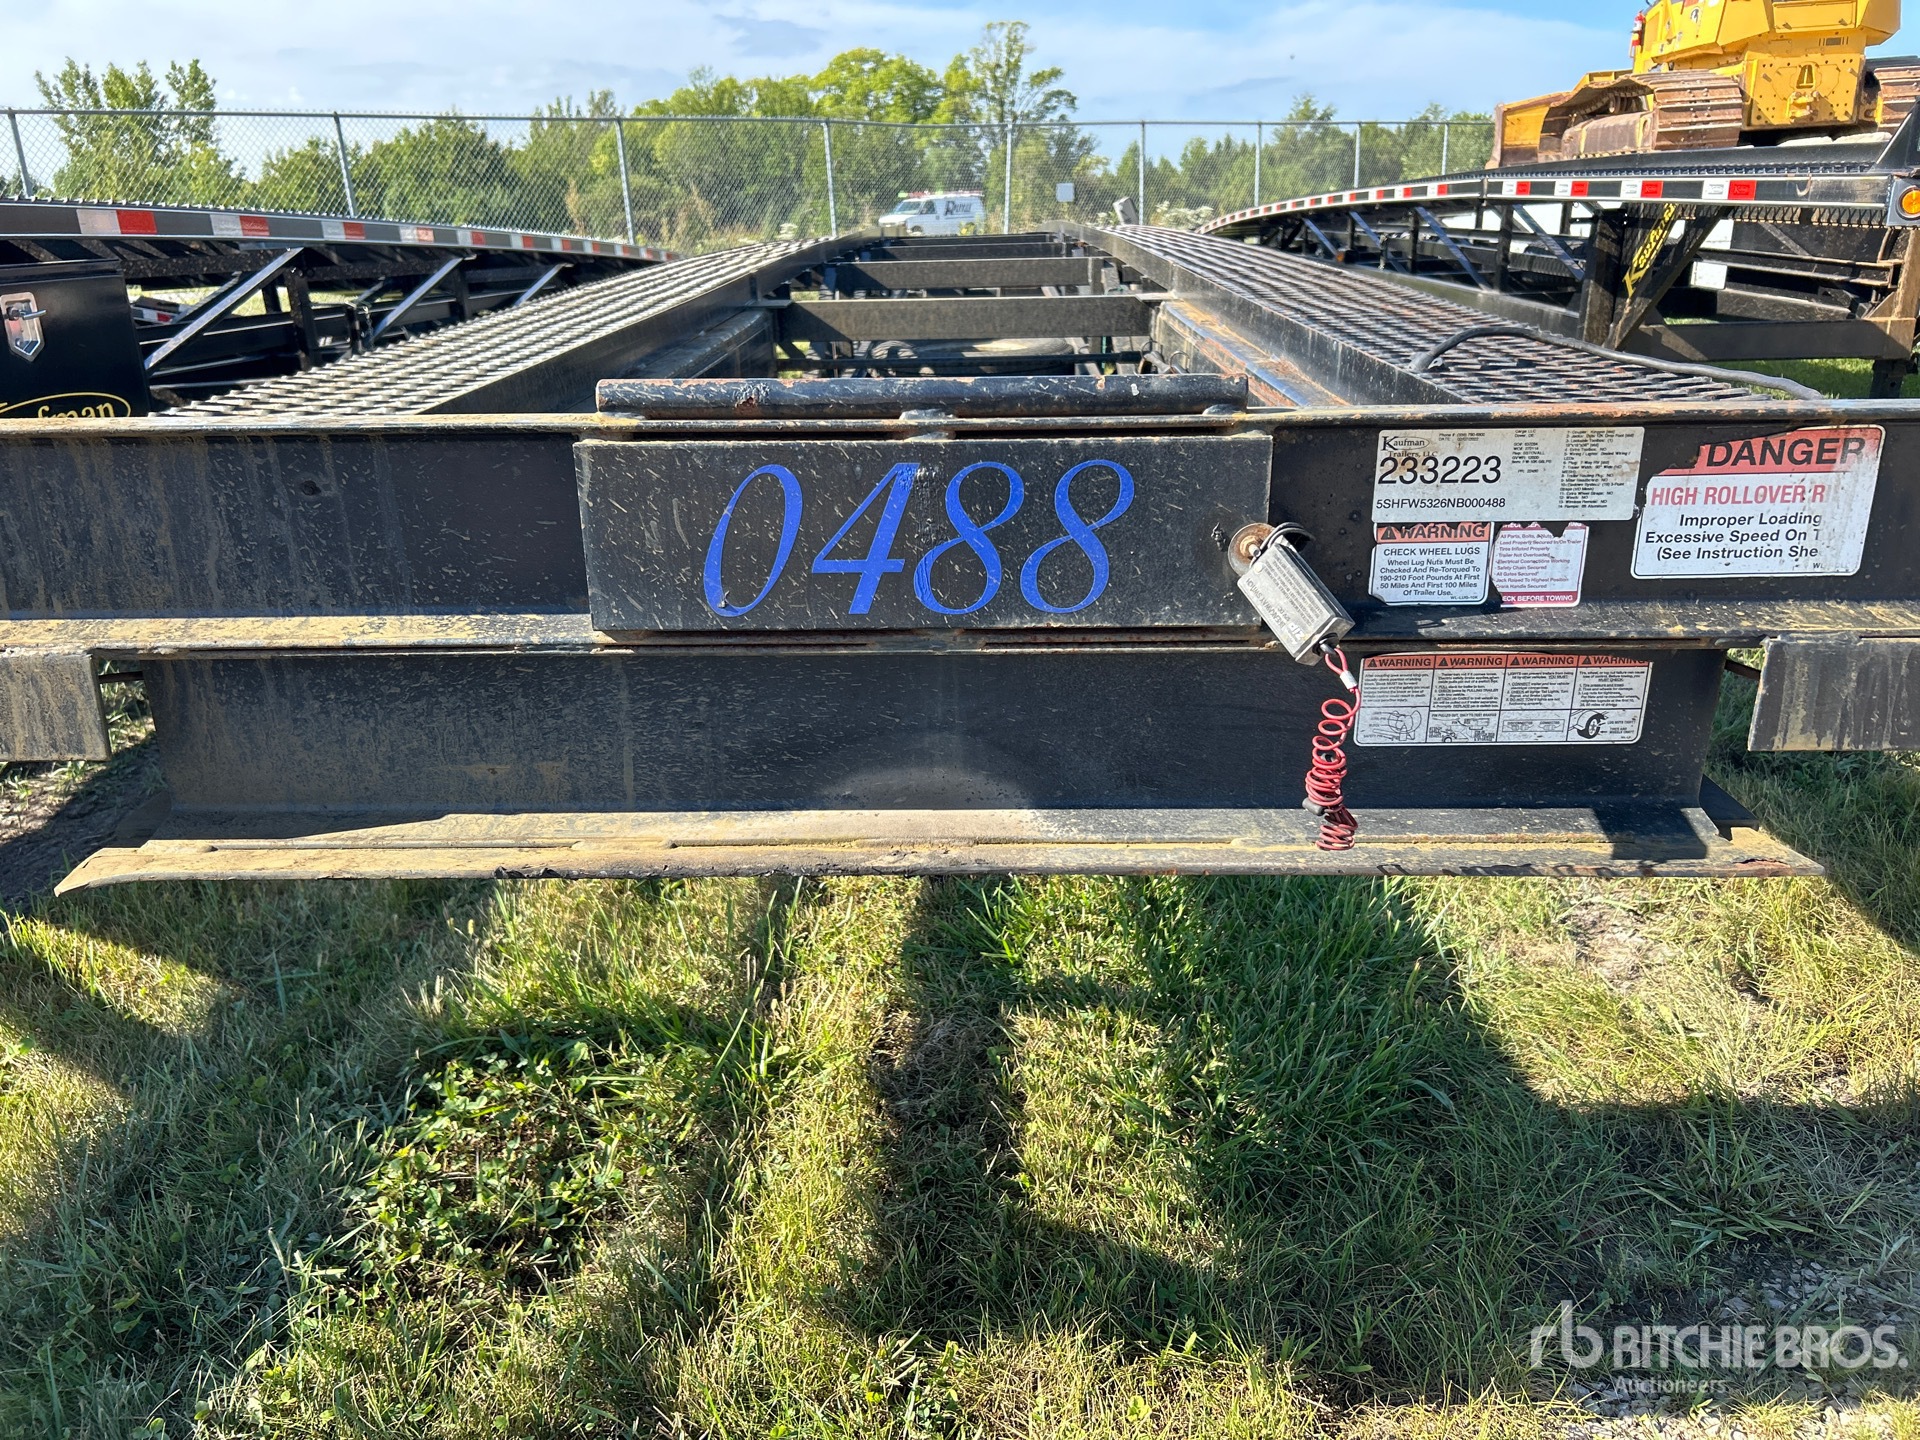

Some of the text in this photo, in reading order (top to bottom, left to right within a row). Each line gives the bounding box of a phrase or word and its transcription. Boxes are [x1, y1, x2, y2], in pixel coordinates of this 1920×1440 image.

[1381, 436, 1425, 451] Kaufman
[1388, 450, 1421, 458] Trailers,
[1706, 437, 1866, 467] DANGER
[1378, 456, 1501, 484] 233223
[1651, 487, 1697, 506] HIGH
[1703, 485, 1805, 505] ROLLOVER
[1376, 498, 1506, 509] 5SHFW5326NB000488
[1680, 513, 1822, 529] Improper Loading
[1400, 525, 1485, 538] WARNING
[1645, 532, 1724, 544] Excessive
[1729, 530, 1780, 545] Speed
[1785, 529, 1807, 541] On
[703, 460, 1134, 617] 0488
[1384, 547, 1480, 556] CHECK WHEEL LUGS
[1657, 545, 1818, 561] (See Instruction She
[1411, 559, 1424, 567] Lug
[1379, 658, 1431, 667] WARNING
[1450, 657, 1502, 666] WARNING
[1522, 656, 1574, 665] WARNING
[1593, 656, 1645, 665] WARNING
